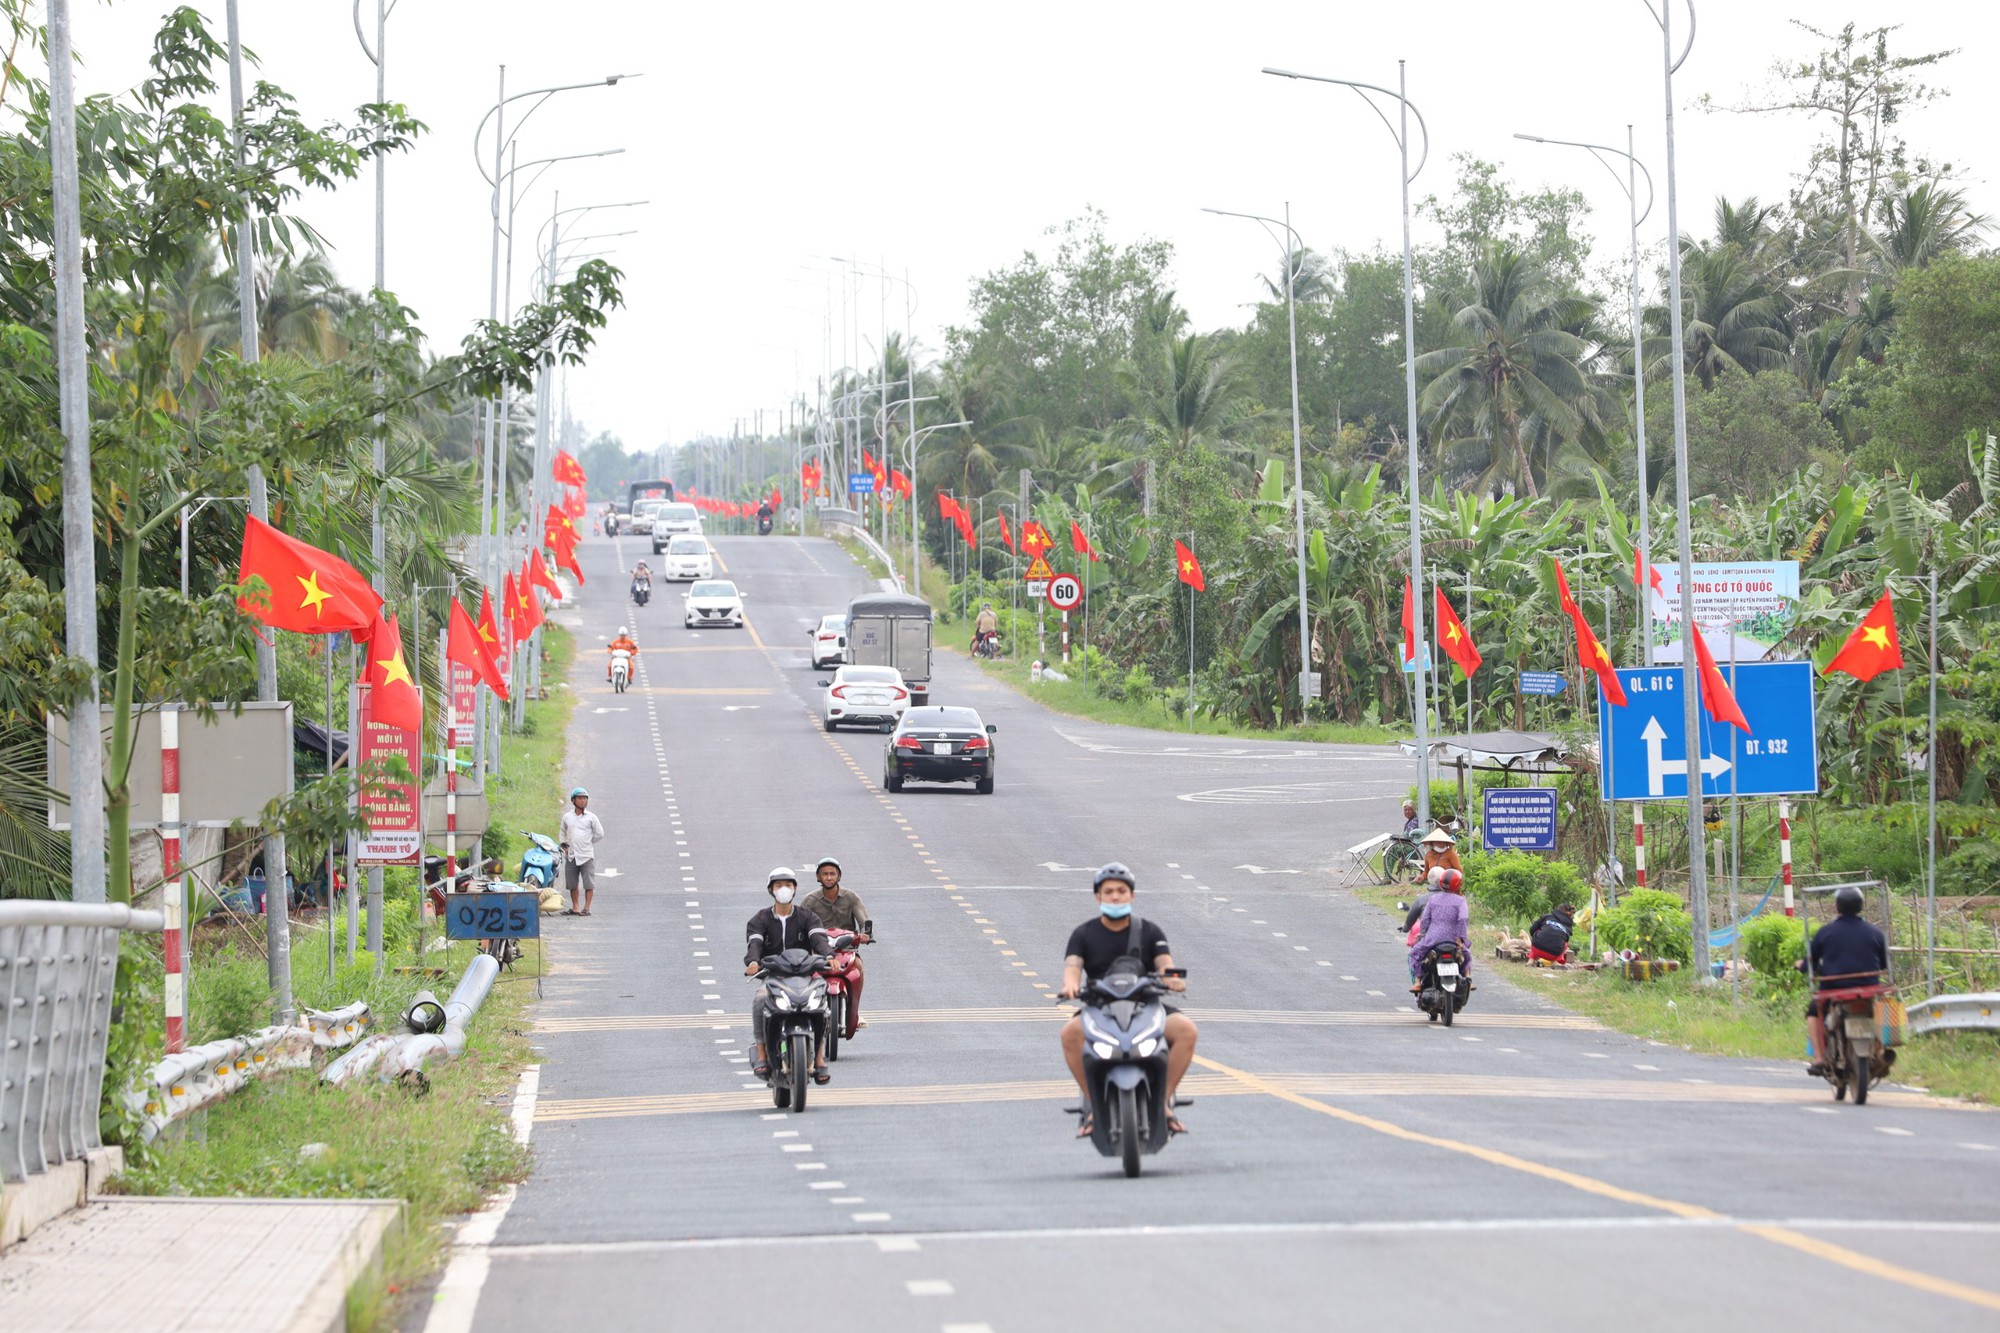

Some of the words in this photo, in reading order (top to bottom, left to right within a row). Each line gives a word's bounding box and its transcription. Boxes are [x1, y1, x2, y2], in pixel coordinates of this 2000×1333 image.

[1055, 584, 1074, 599] 60
[1714, 580, 1728, 593] CỜ
[1730, 578, 1743, 593] TỔ
[1745, 578, 1773, 593] QUỐC
[1630, 677, 1648, 694] QL.
[1651, 676, 1663, 691] 61
[377, 733, 393, 744] MỚI
[394, 733, 403, 744] VÌ
[1768, 738, 1789, 754] 932
[366, 845, 398, 853] THANH
[459, 905, 527, 933] 0725
